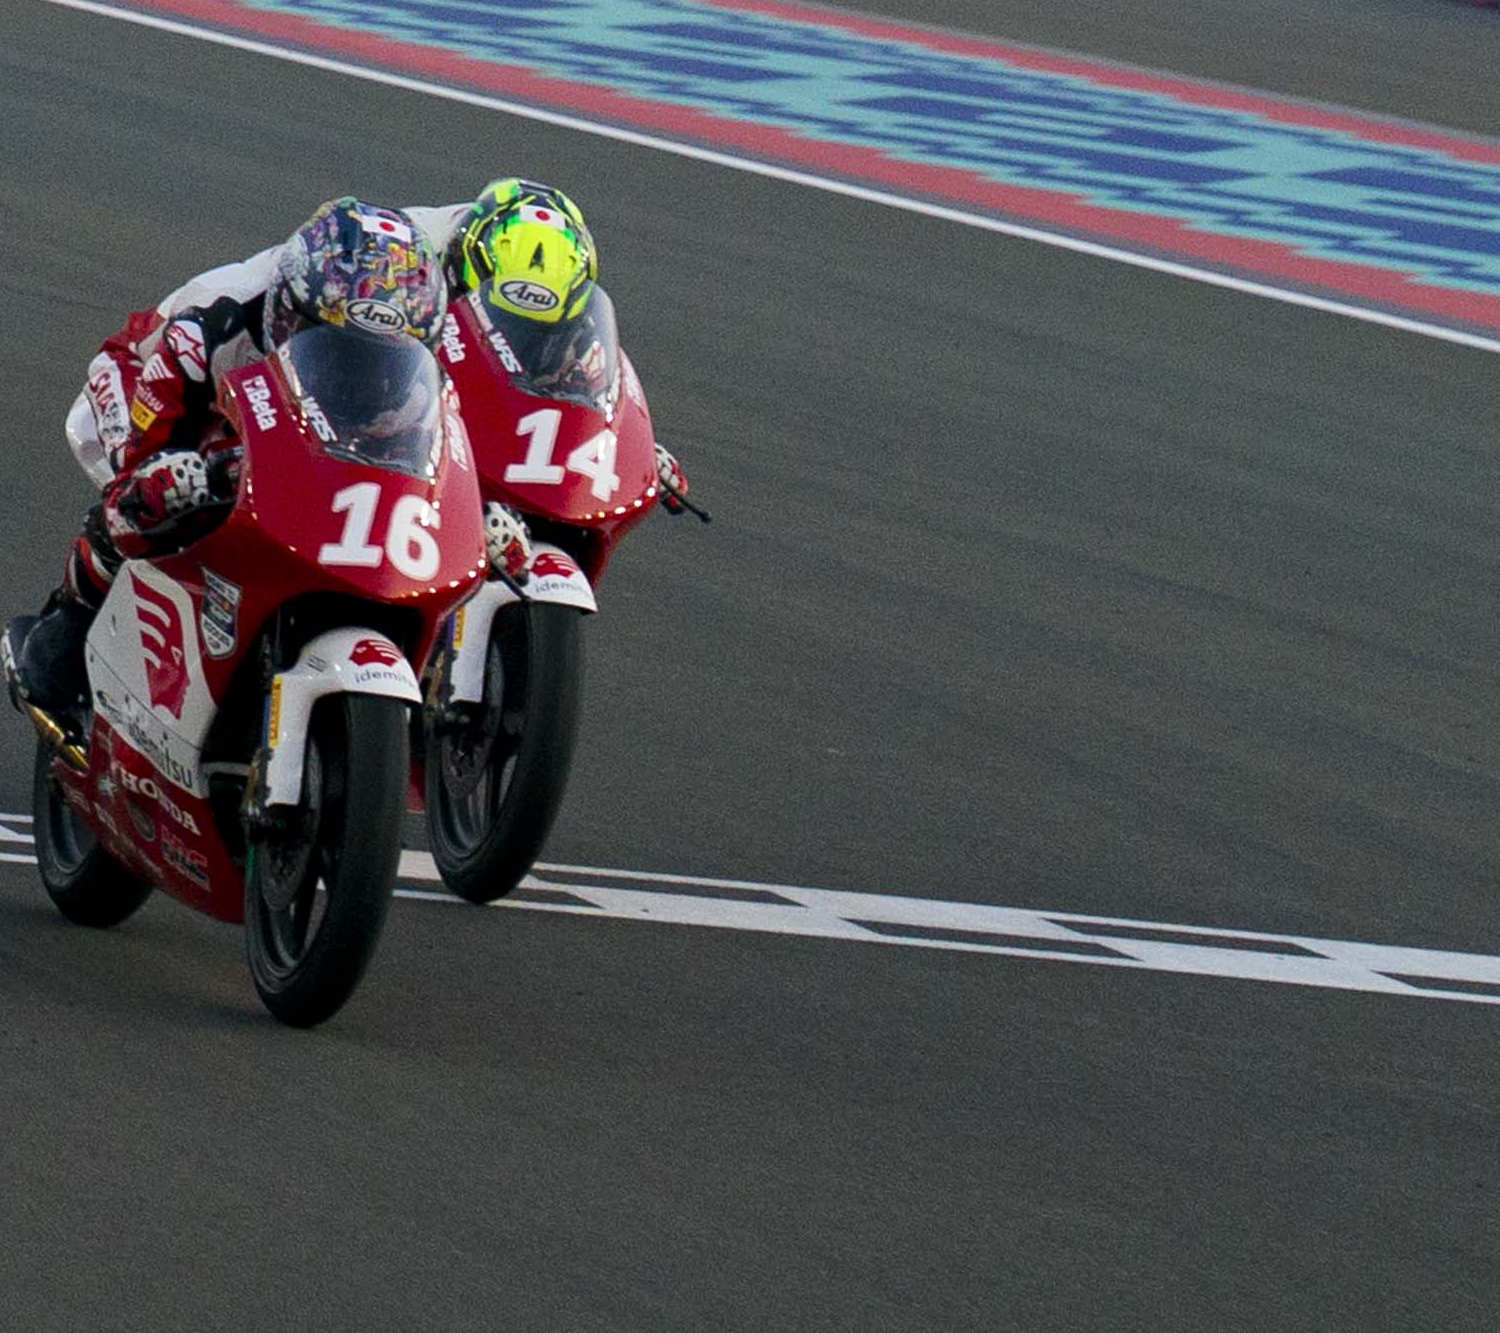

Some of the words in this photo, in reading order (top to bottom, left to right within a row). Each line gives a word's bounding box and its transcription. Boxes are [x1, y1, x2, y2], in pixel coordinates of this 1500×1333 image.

[358, 304, 398, 326] Arai
[512, 284, 552, 305] Arai
[247, 387, 278, 432] Beta
[503, 407, 620, 503] 14
[316, 481, 442, 582] 16
[119, 766, 202, 836] HONDA
